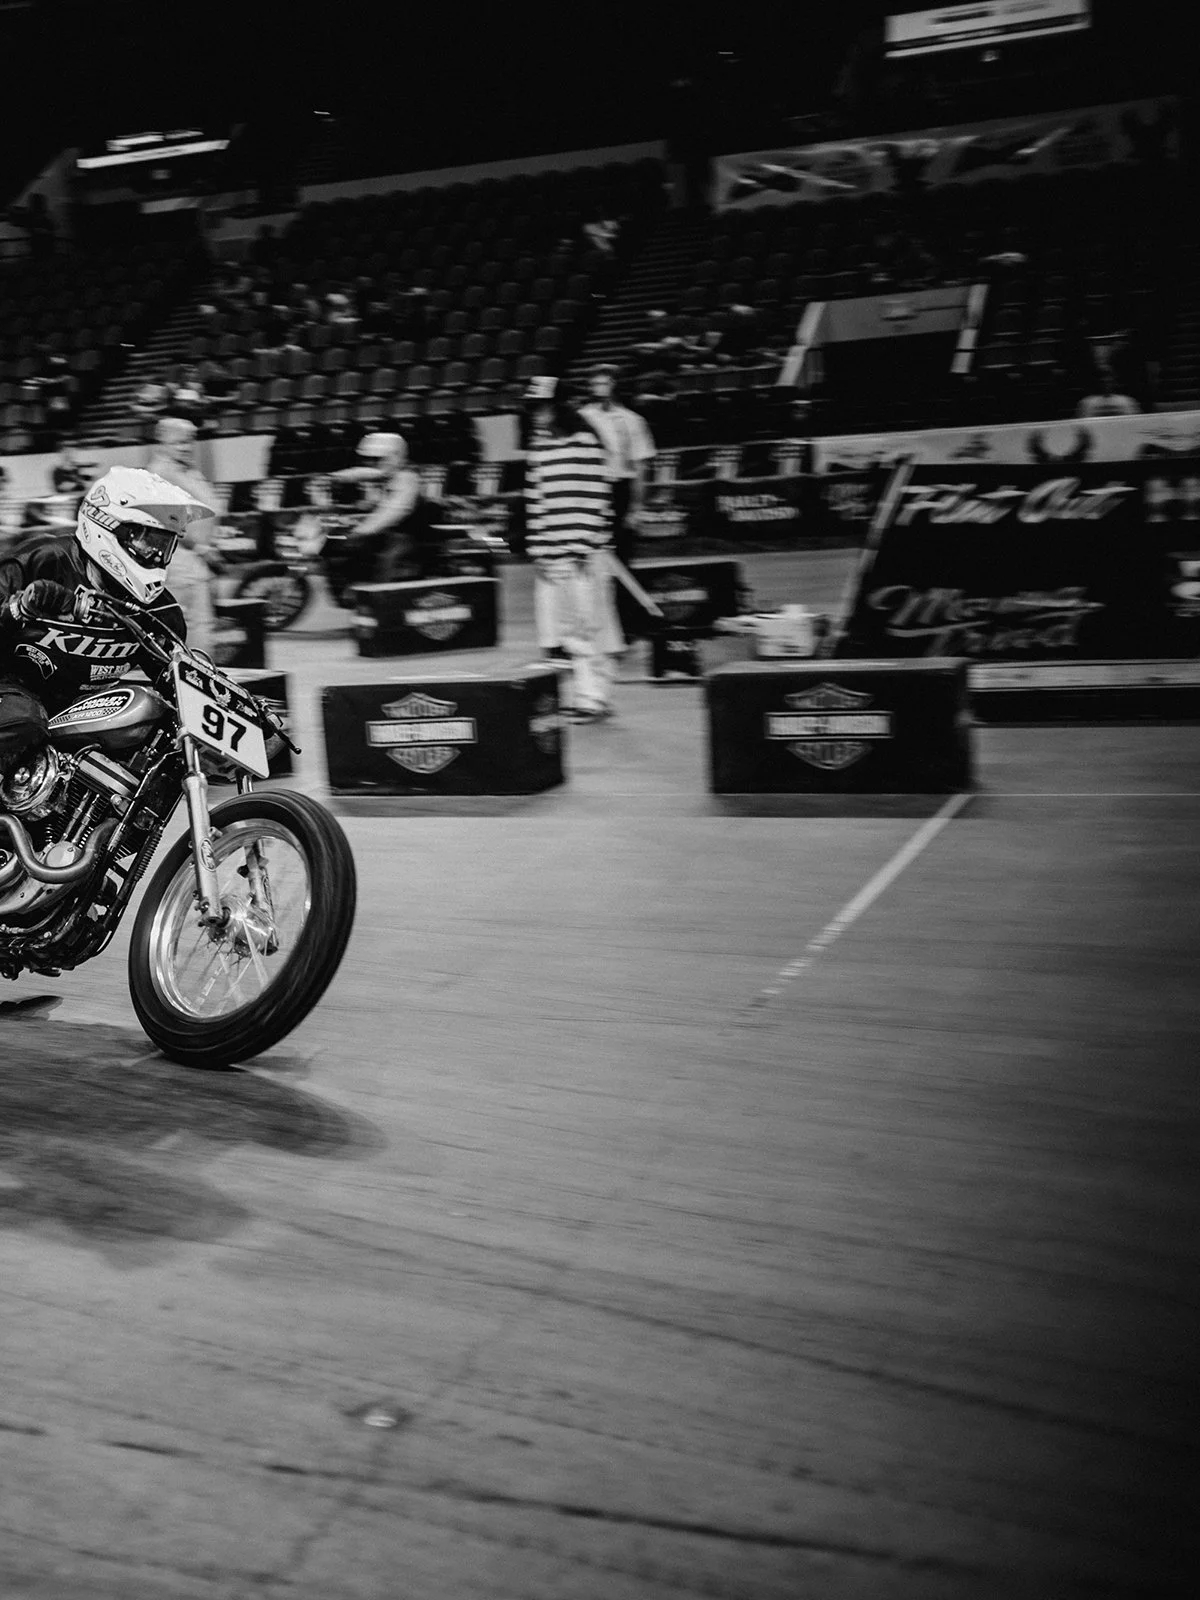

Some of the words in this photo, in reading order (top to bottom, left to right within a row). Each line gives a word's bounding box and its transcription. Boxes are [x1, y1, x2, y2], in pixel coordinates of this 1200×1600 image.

[35, 627, 140, 658] Klim
[90, 664, 116, 676] WEST
[201, 704, 247, 752] 97
